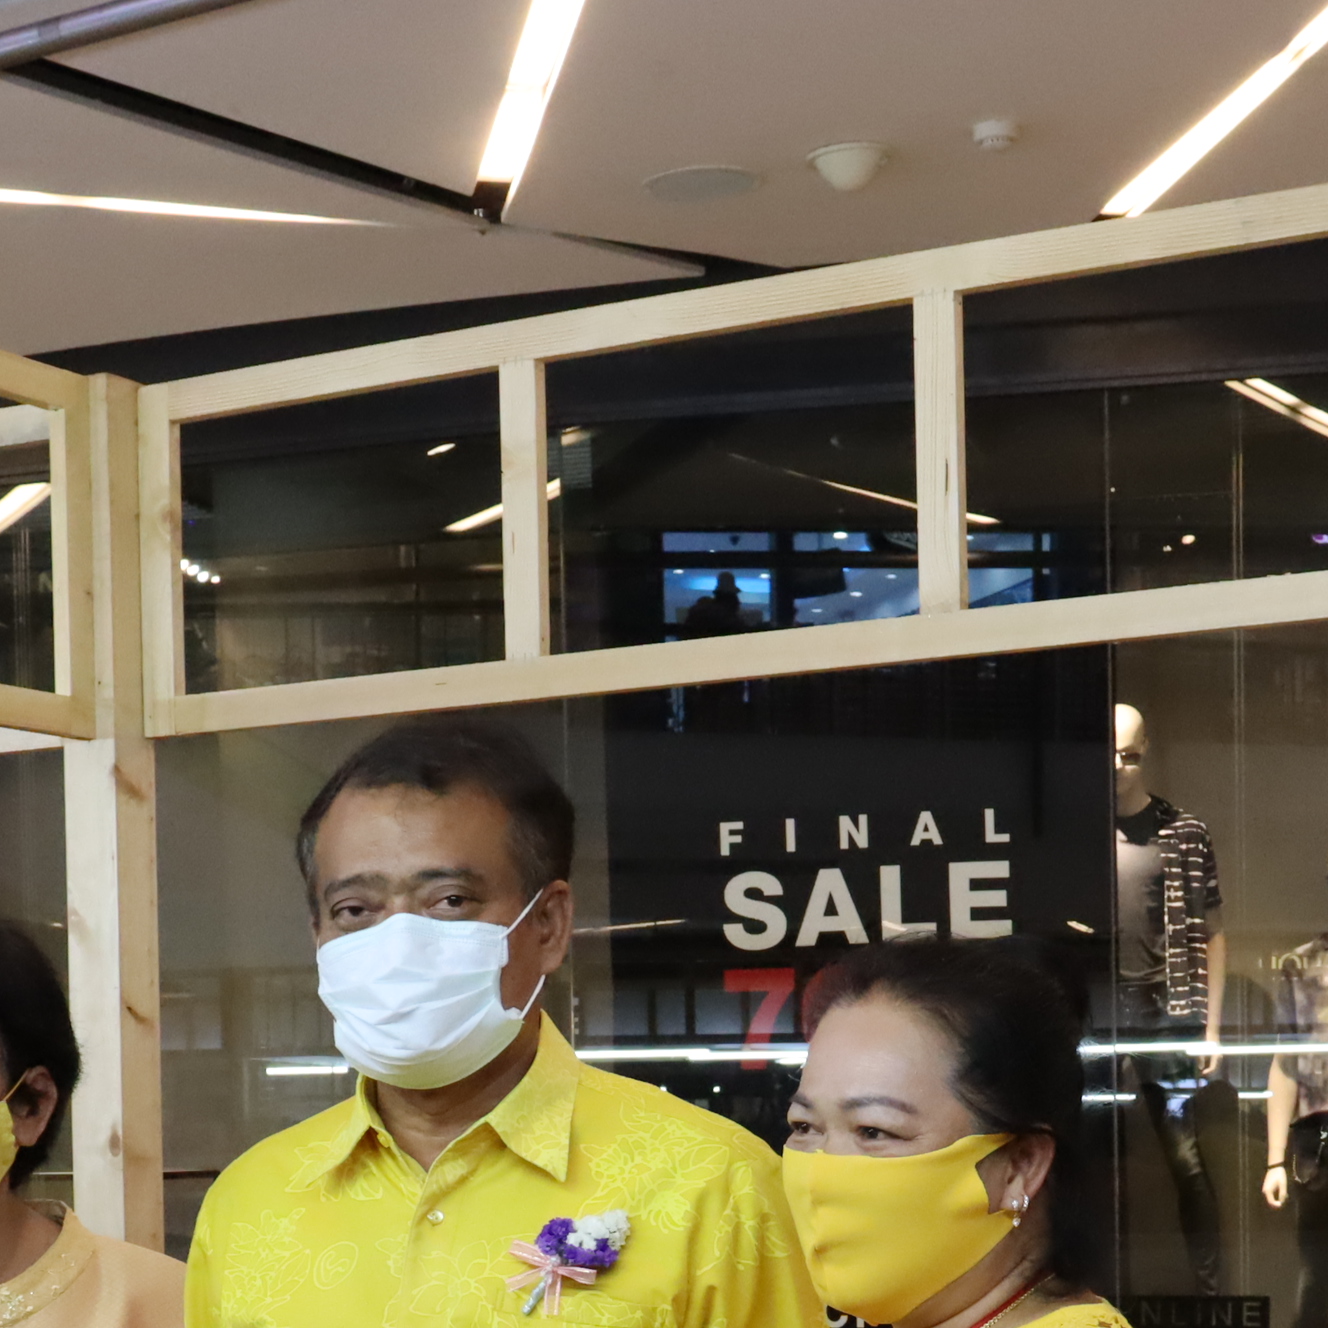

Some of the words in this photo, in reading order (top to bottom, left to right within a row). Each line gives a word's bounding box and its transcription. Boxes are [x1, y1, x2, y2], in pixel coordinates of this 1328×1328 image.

[719, 808, 1011, 856] FINAL
[723, 859, 1013, 952] SALE
[1140, 1300, 1262, 1328] NLINE
